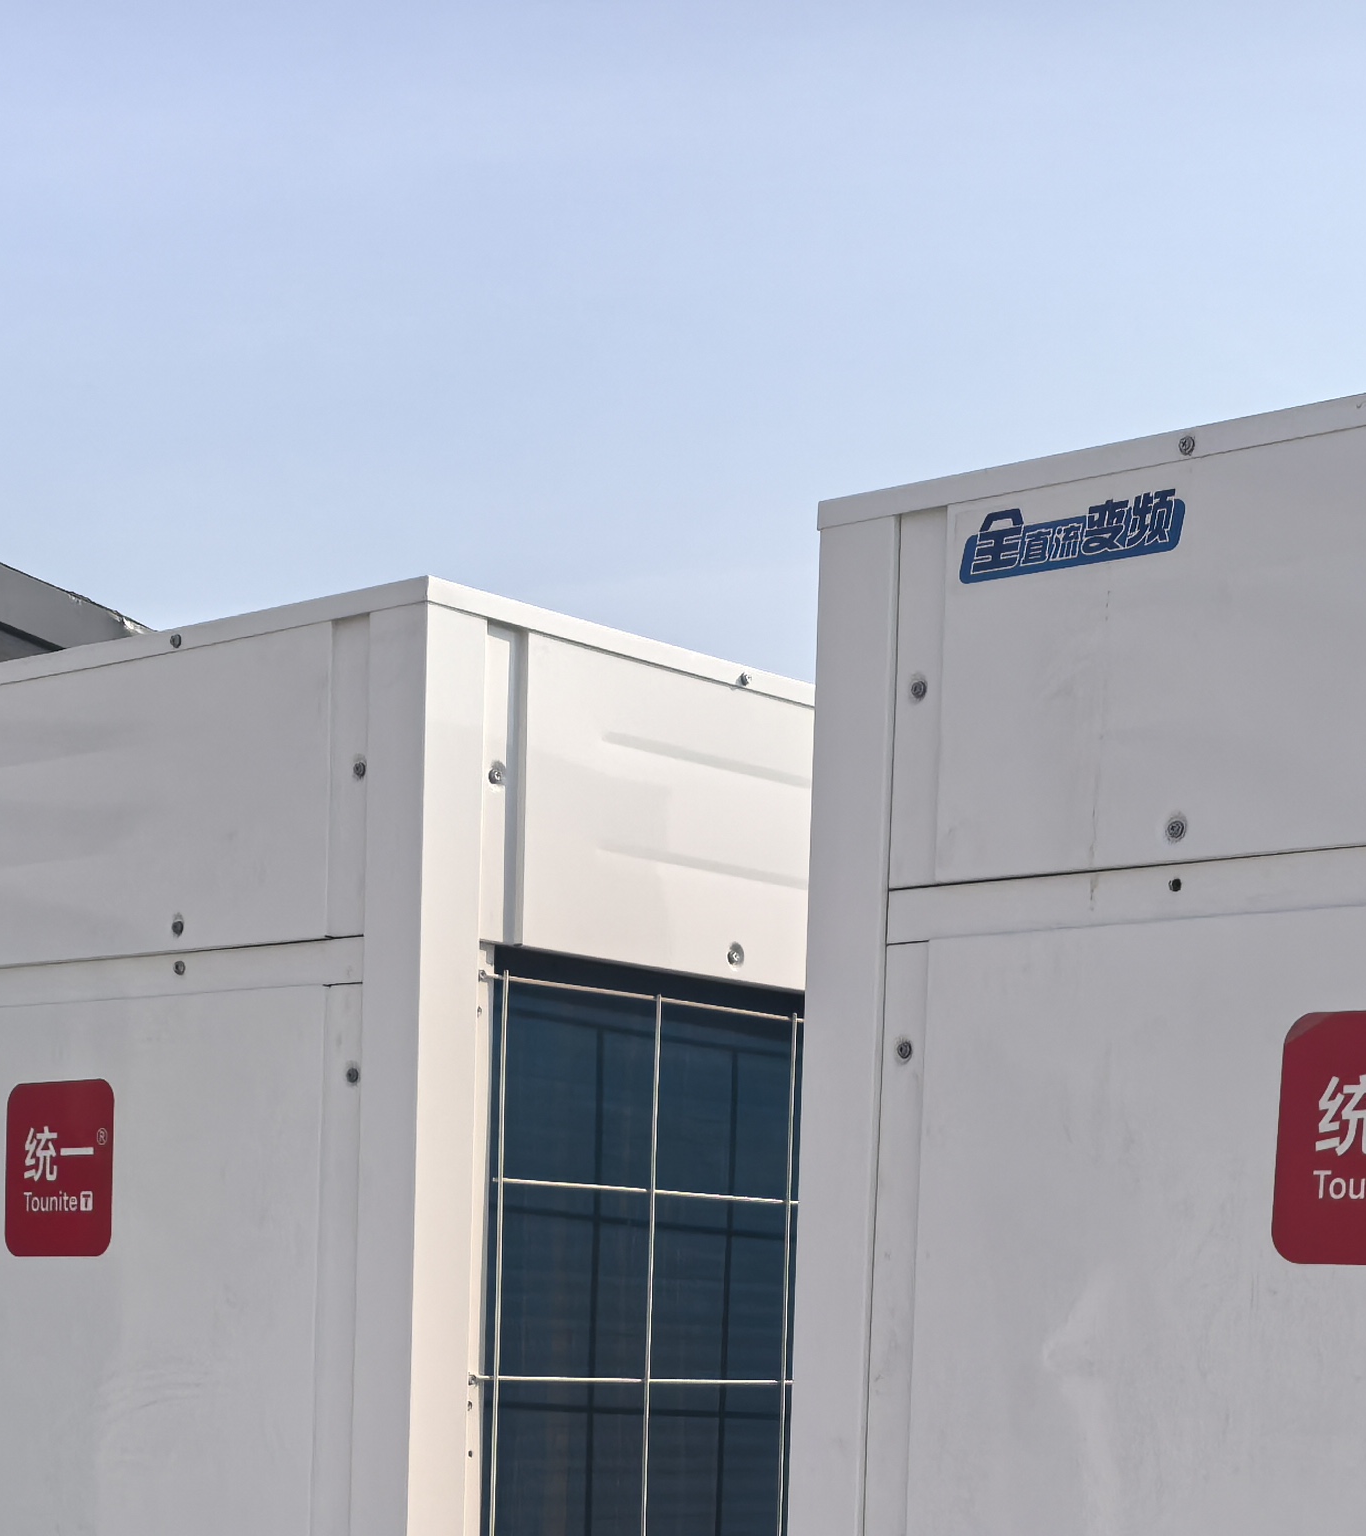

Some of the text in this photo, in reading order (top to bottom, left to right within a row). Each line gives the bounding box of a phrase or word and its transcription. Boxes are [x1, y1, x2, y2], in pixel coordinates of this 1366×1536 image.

[969, 488, 1177, 575] 全直流变频
[23, 1125, 95, 1182] 统一
[23, 1190, 78, 1213] Tounite
